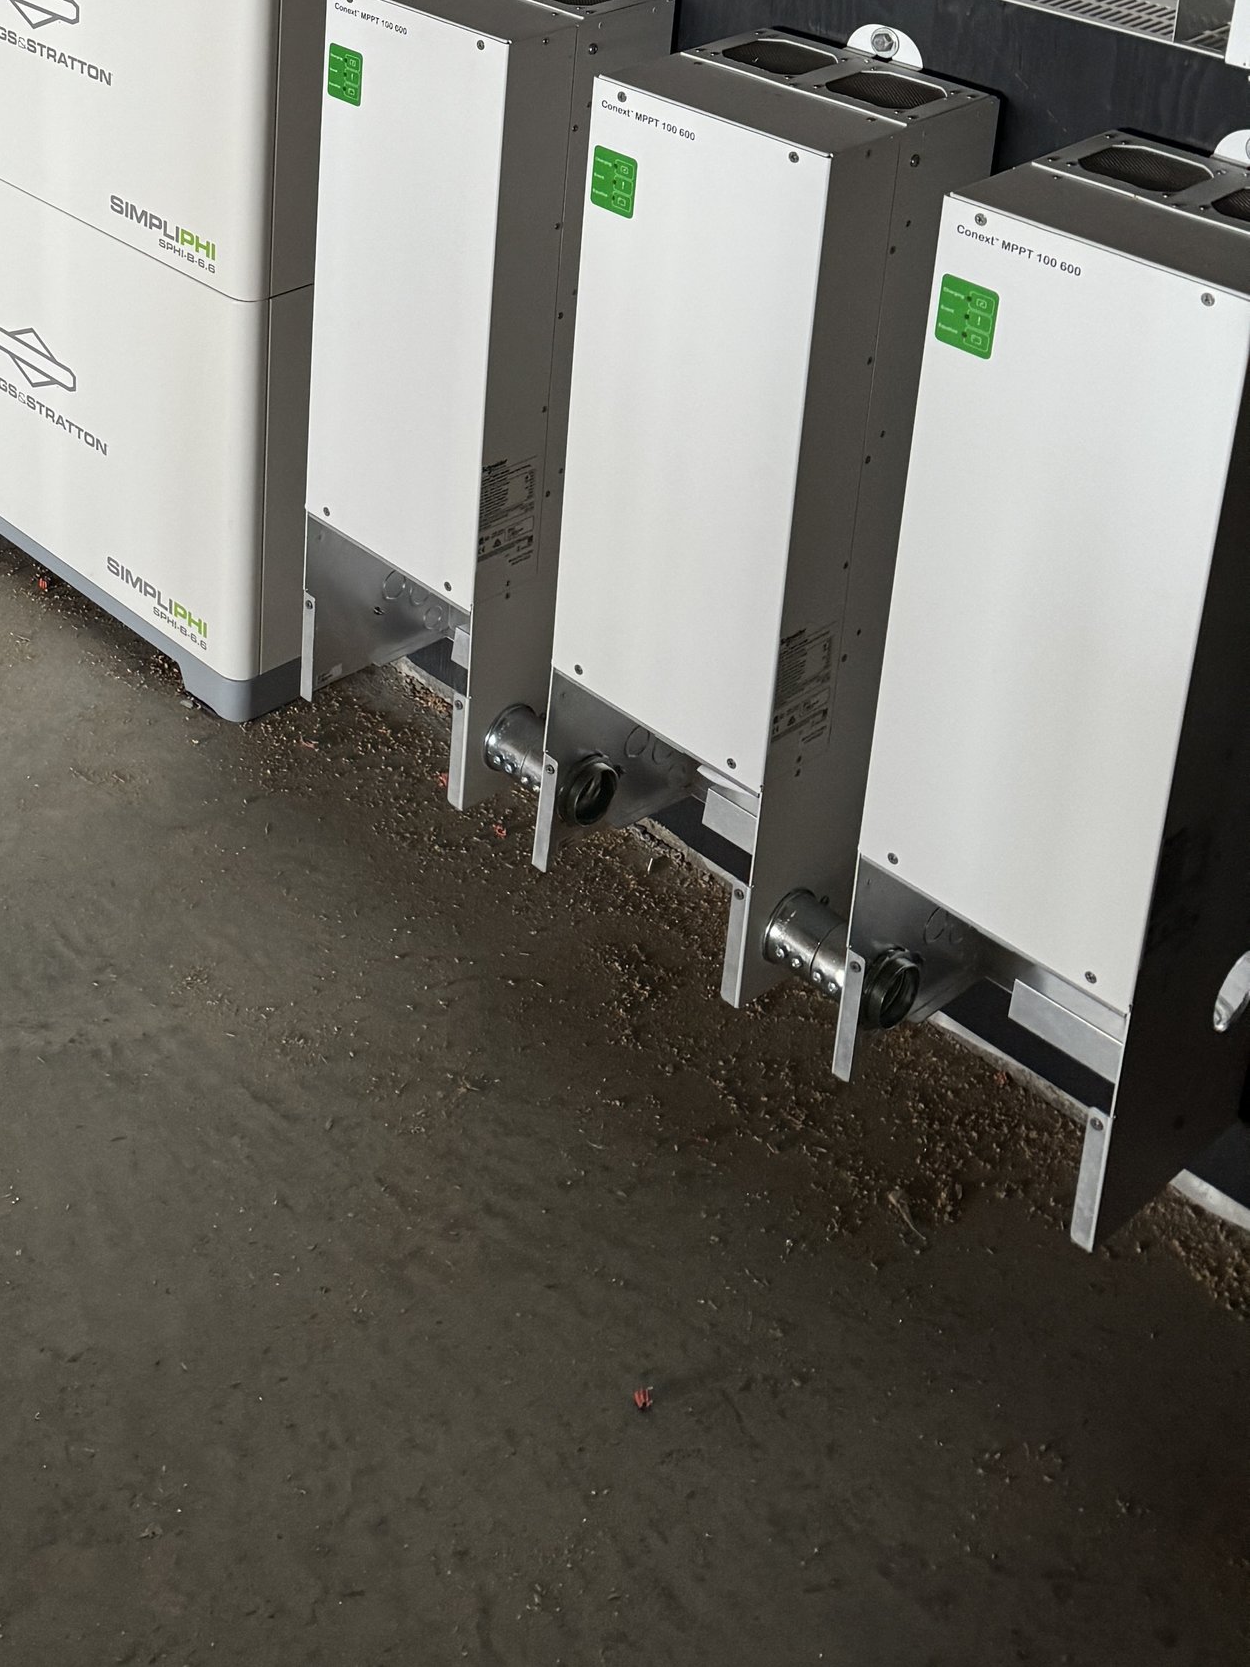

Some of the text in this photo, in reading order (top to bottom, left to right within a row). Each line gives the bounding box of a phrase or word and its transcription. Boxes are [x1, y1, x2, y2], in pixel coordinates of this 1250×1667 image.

[360, 11, 380, 25] MPPT
[381, 19, 394, 30] 100
[635, 111, 660, 128] MPPT
[662, 121, 678, 135] 100
[679, 128, 696, 141] 600
[110, 194, 216, 260] SIMPLIPHI
[1001, 239, 1034, 260] MPPT
[1036, 252, 1058, 269] 100
[1059, 260, 1083, 277] 600
[106, 555, 208, 639] SIMPLIPHI
